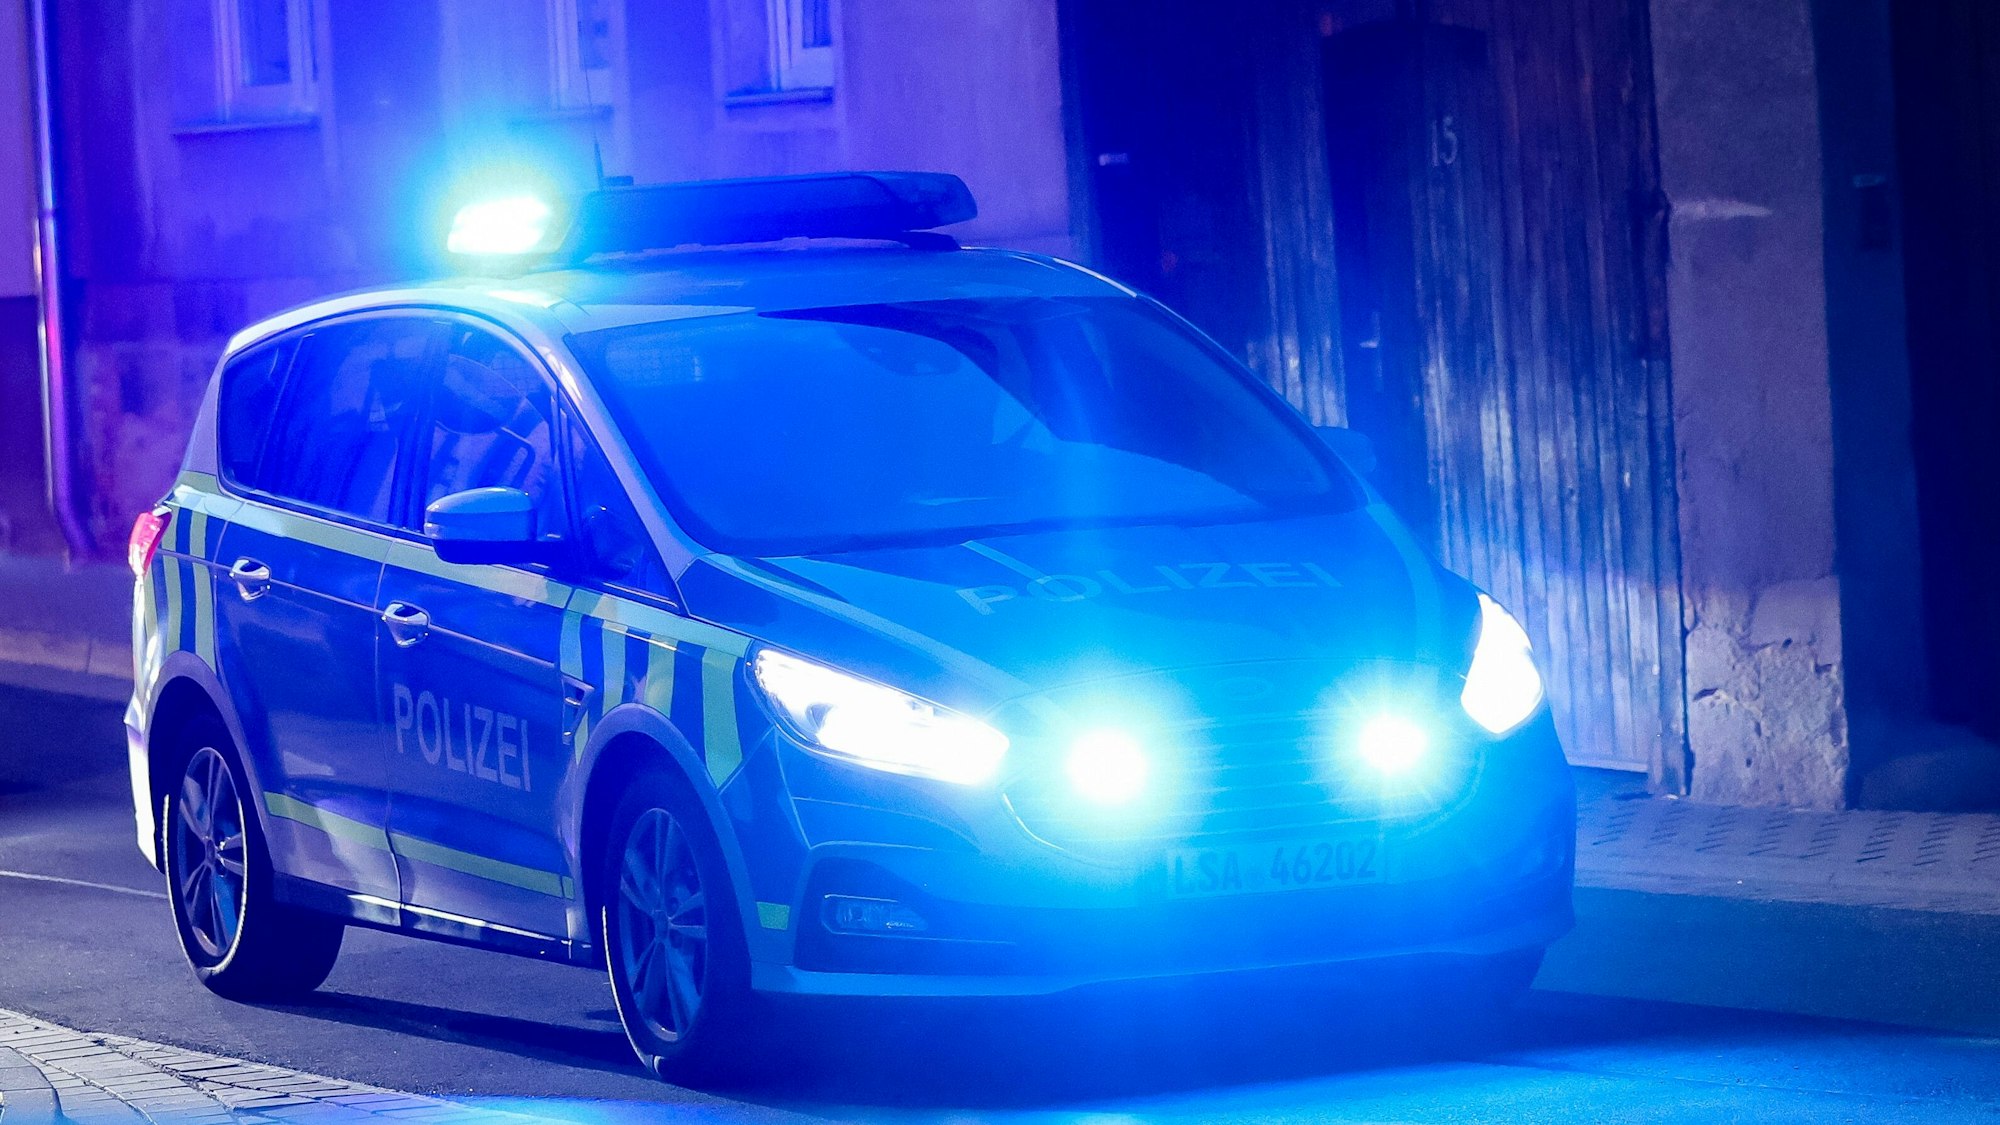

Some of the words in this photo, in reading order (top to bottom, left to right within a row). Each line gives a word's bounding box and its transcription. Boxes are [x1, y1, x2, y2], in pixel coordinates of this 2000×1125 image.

[1431, 116, 1458, 167] 15
[955, 562, 1344, 615] POLIZEI
[393, 682, 532, 793] POLIZEI
[1175, 851, 1243, 894] LSA
[1269, 840, 1377, 886] 46202
